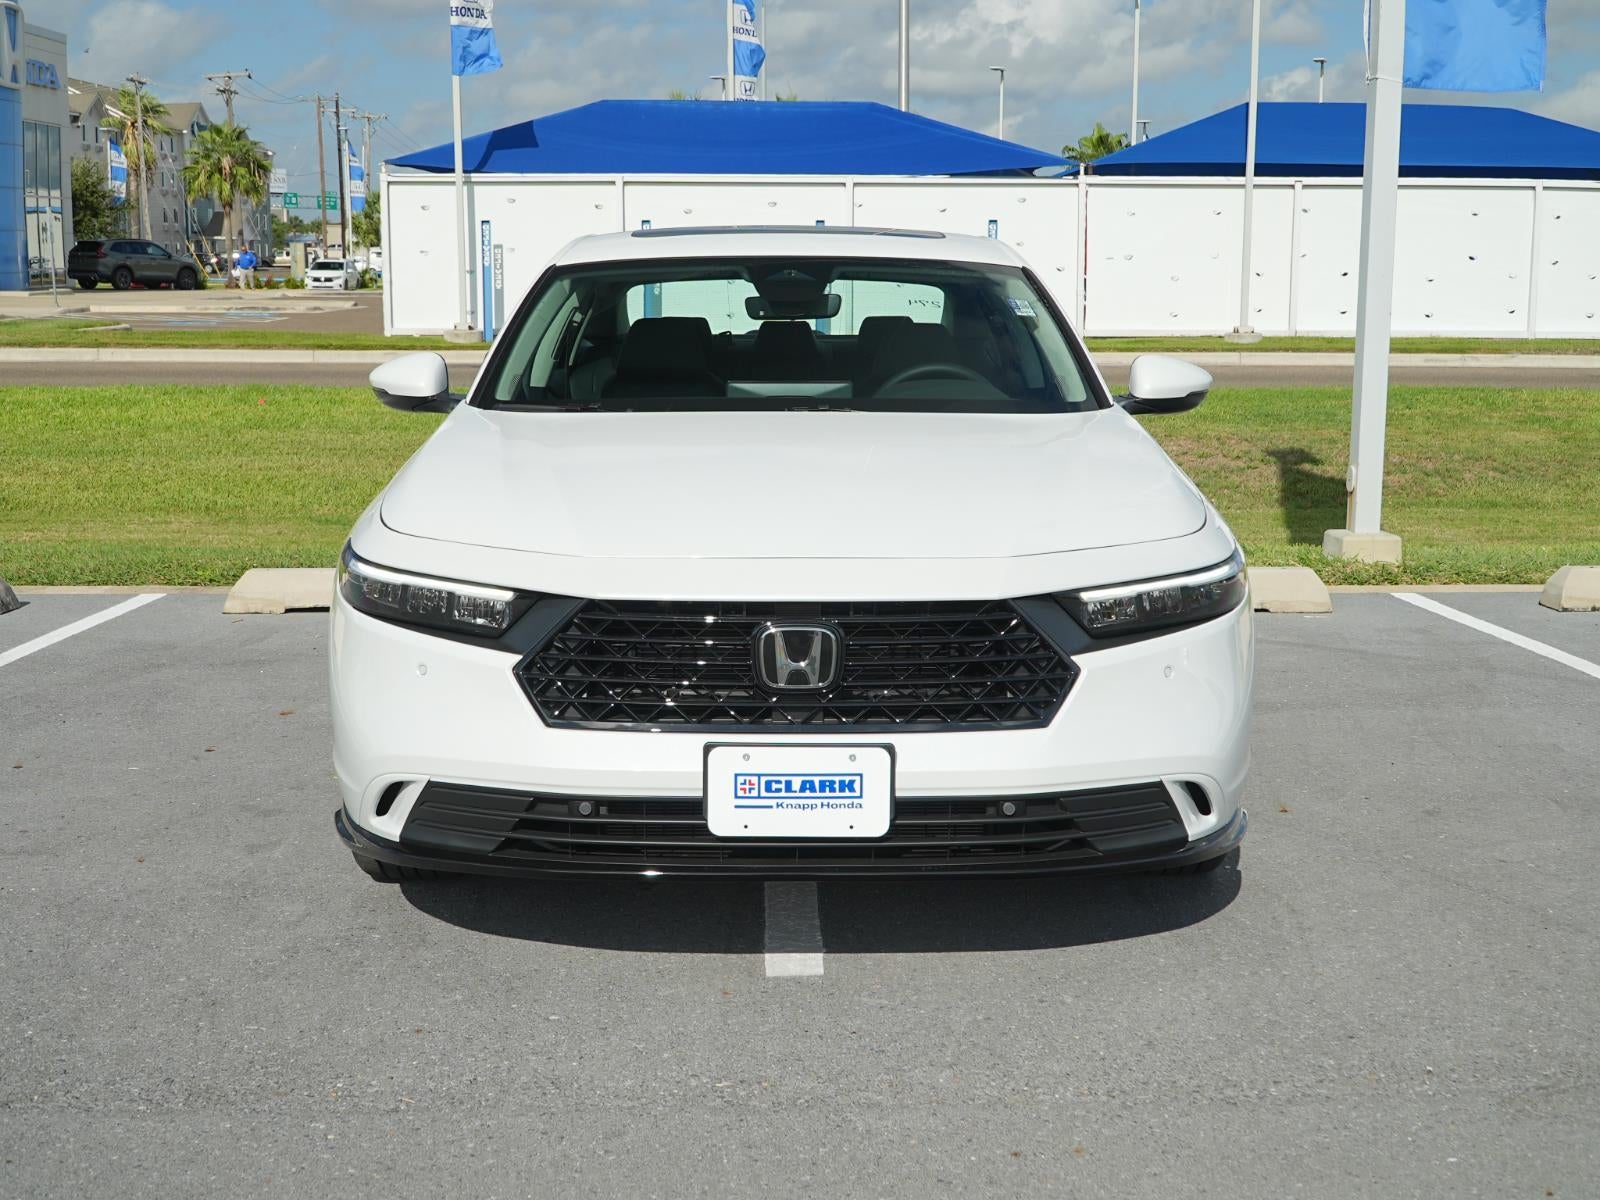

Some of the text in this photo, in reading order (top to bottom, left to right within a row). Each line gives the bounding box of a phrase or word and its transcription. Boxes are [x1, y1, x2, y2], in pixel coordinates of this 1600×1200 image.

[450, 6, 487, 19] HONDA
[764, 779, 857, 793] CLARK
[776, 801, 863, 811] Knapp Honda
